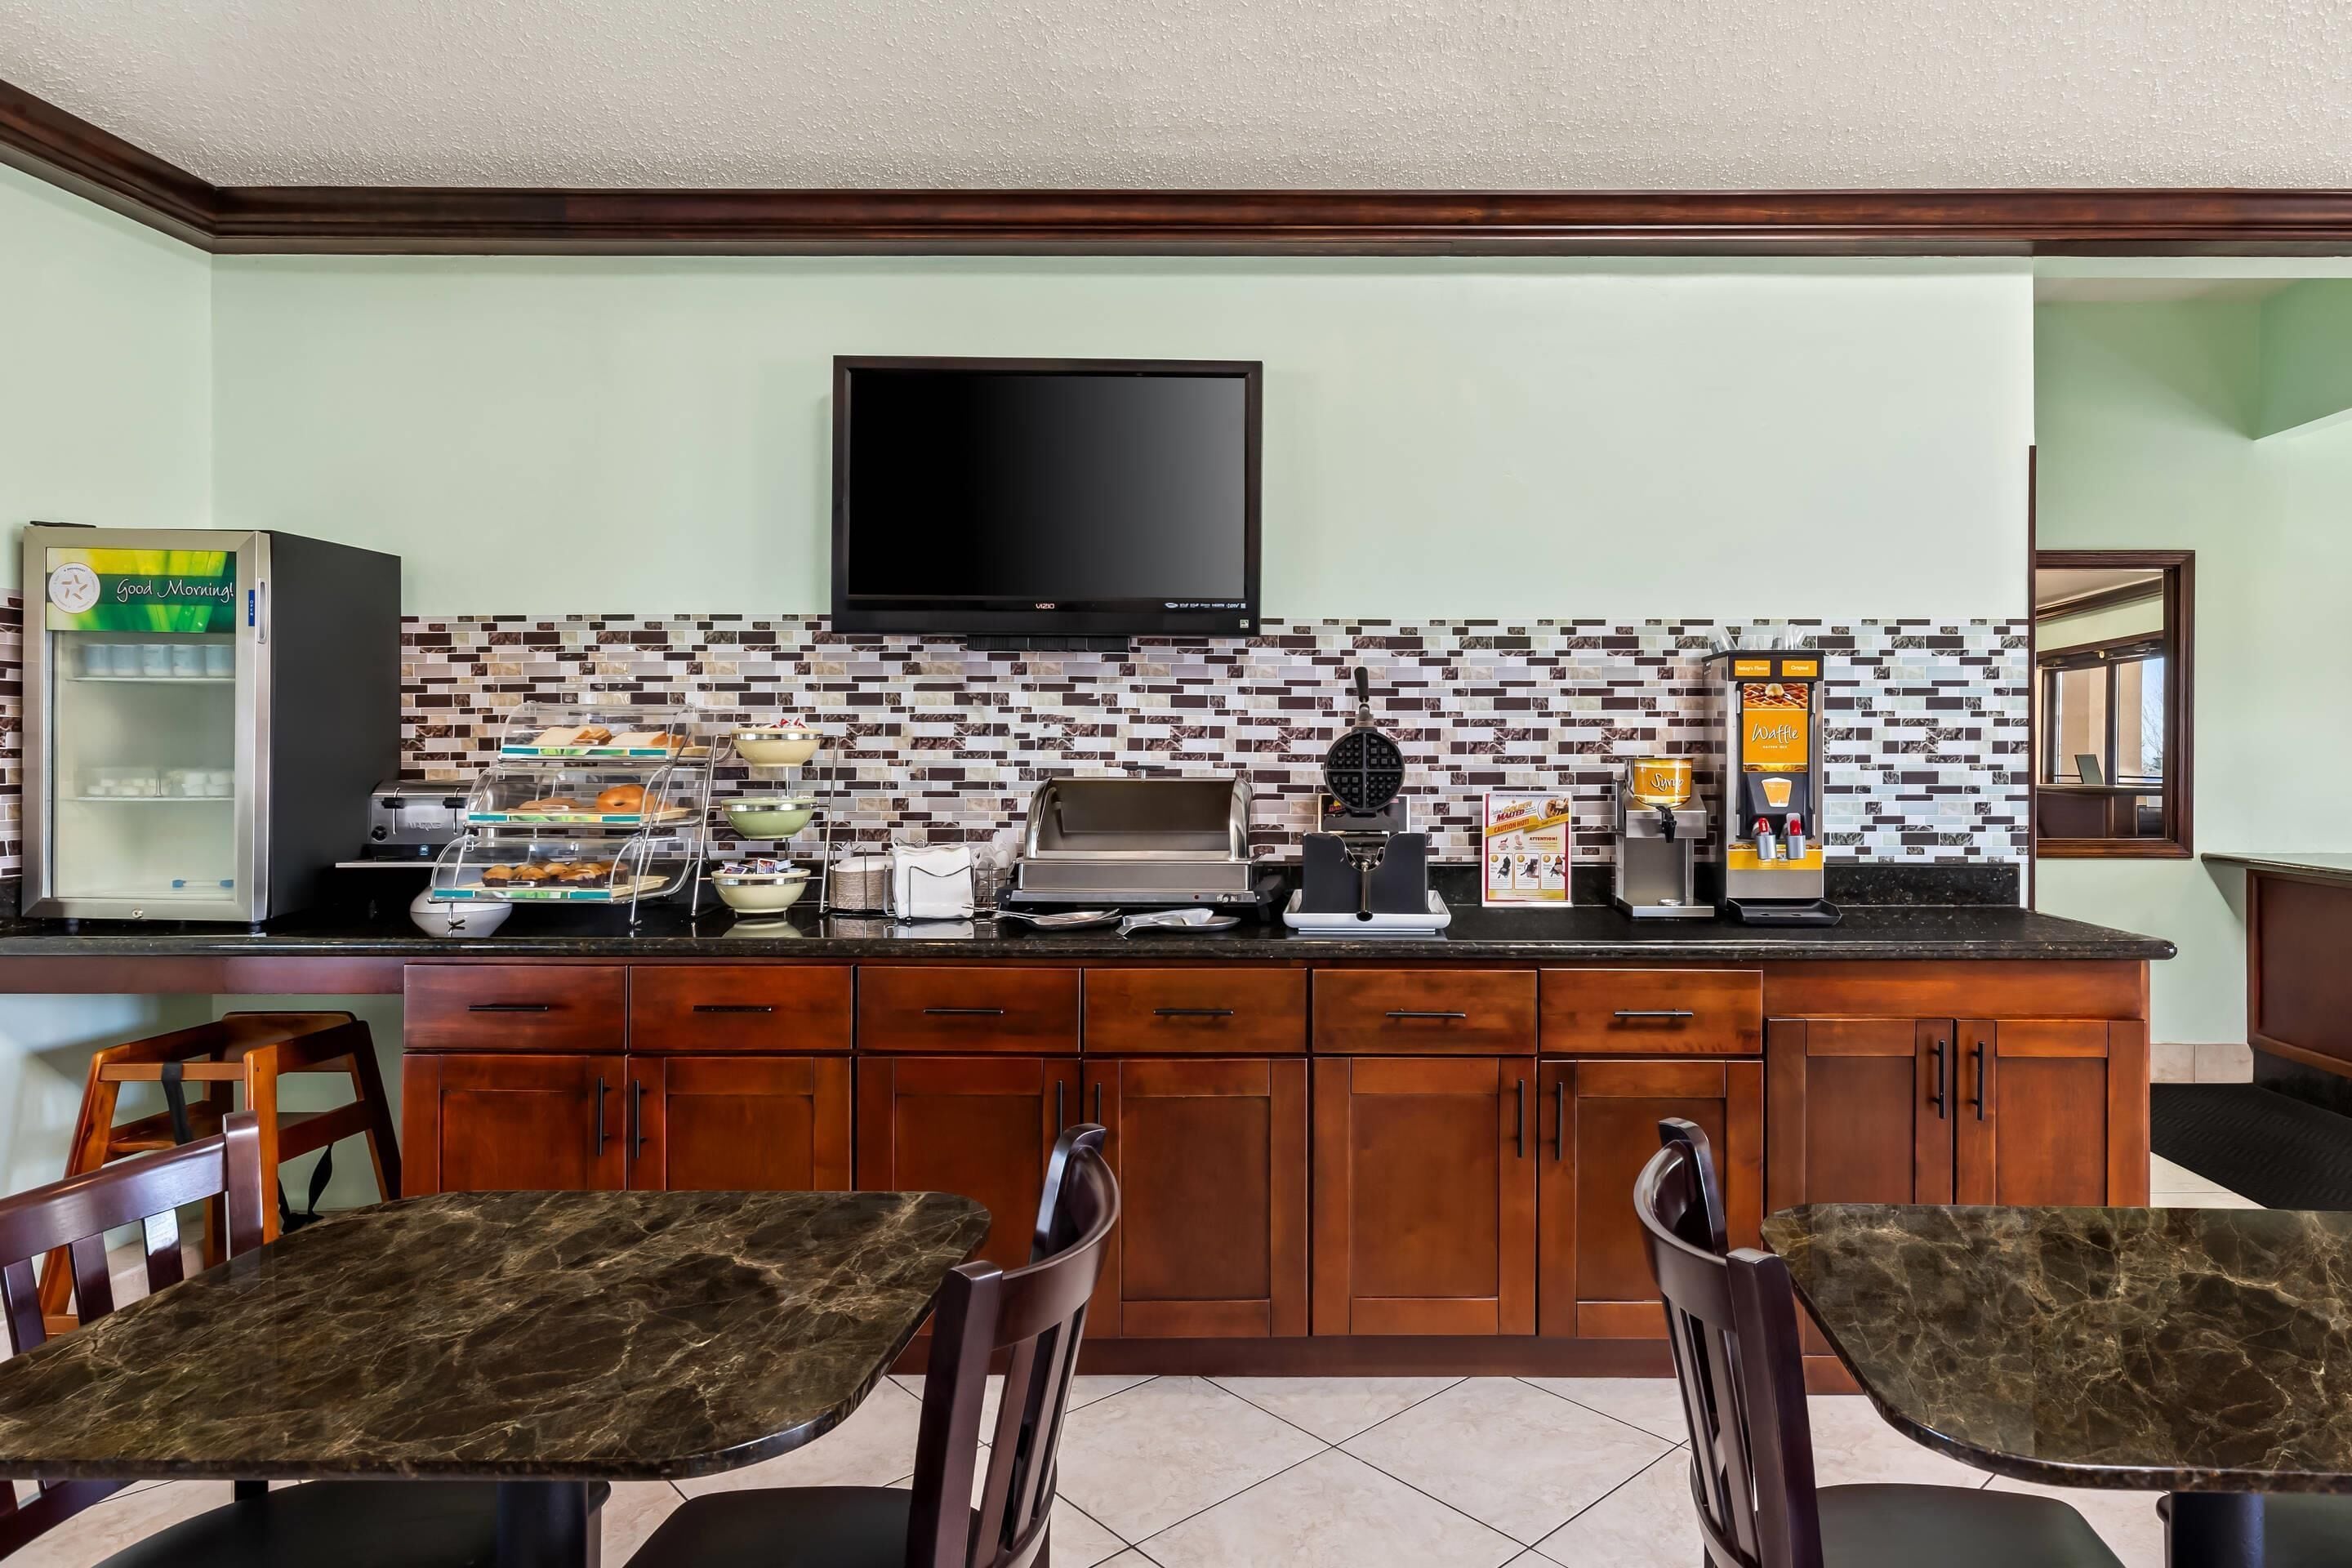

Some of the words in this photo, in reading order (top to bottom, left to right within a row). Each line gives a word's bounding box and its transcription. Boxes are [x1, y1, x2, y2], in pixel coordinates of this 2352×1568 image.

[117, 578, 152, 602] Good
[157, 579, 235, 603] Morning!
[1752, 724, 1798, 744] Waffle
[1651, 773, 1684, 792] Syrup
[1496, 808, 1525, 822] MALTED
[1494, 822, 1517, 833] CAUTION
[1517, 818, 1530, 828] HOT!
